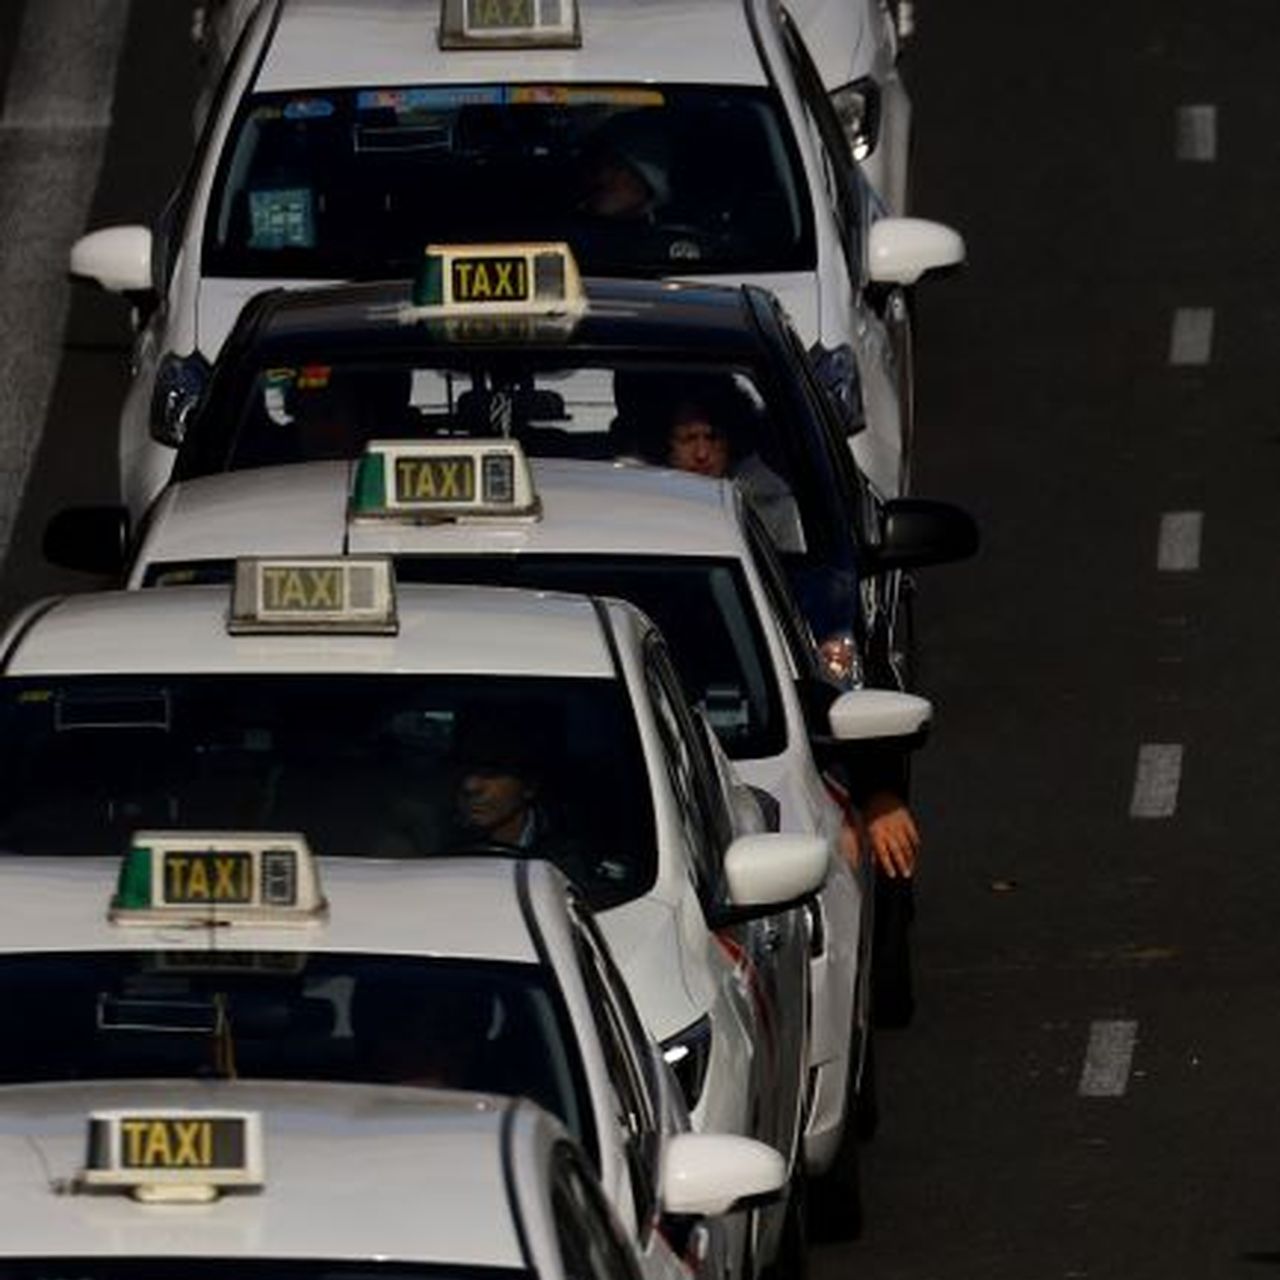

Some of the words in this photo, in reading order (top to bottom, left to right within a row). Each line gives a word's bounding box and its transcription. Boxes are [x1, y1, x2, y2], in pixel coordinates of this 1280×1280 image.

[455, 263, 524, 297] TAXI
[399, 461, 472, 498] TAXI
[264, 570, 341, 608] TAXI
[169, 858, 249, 898] TAXI
[124, 1123, 213, 1165] TAXI
